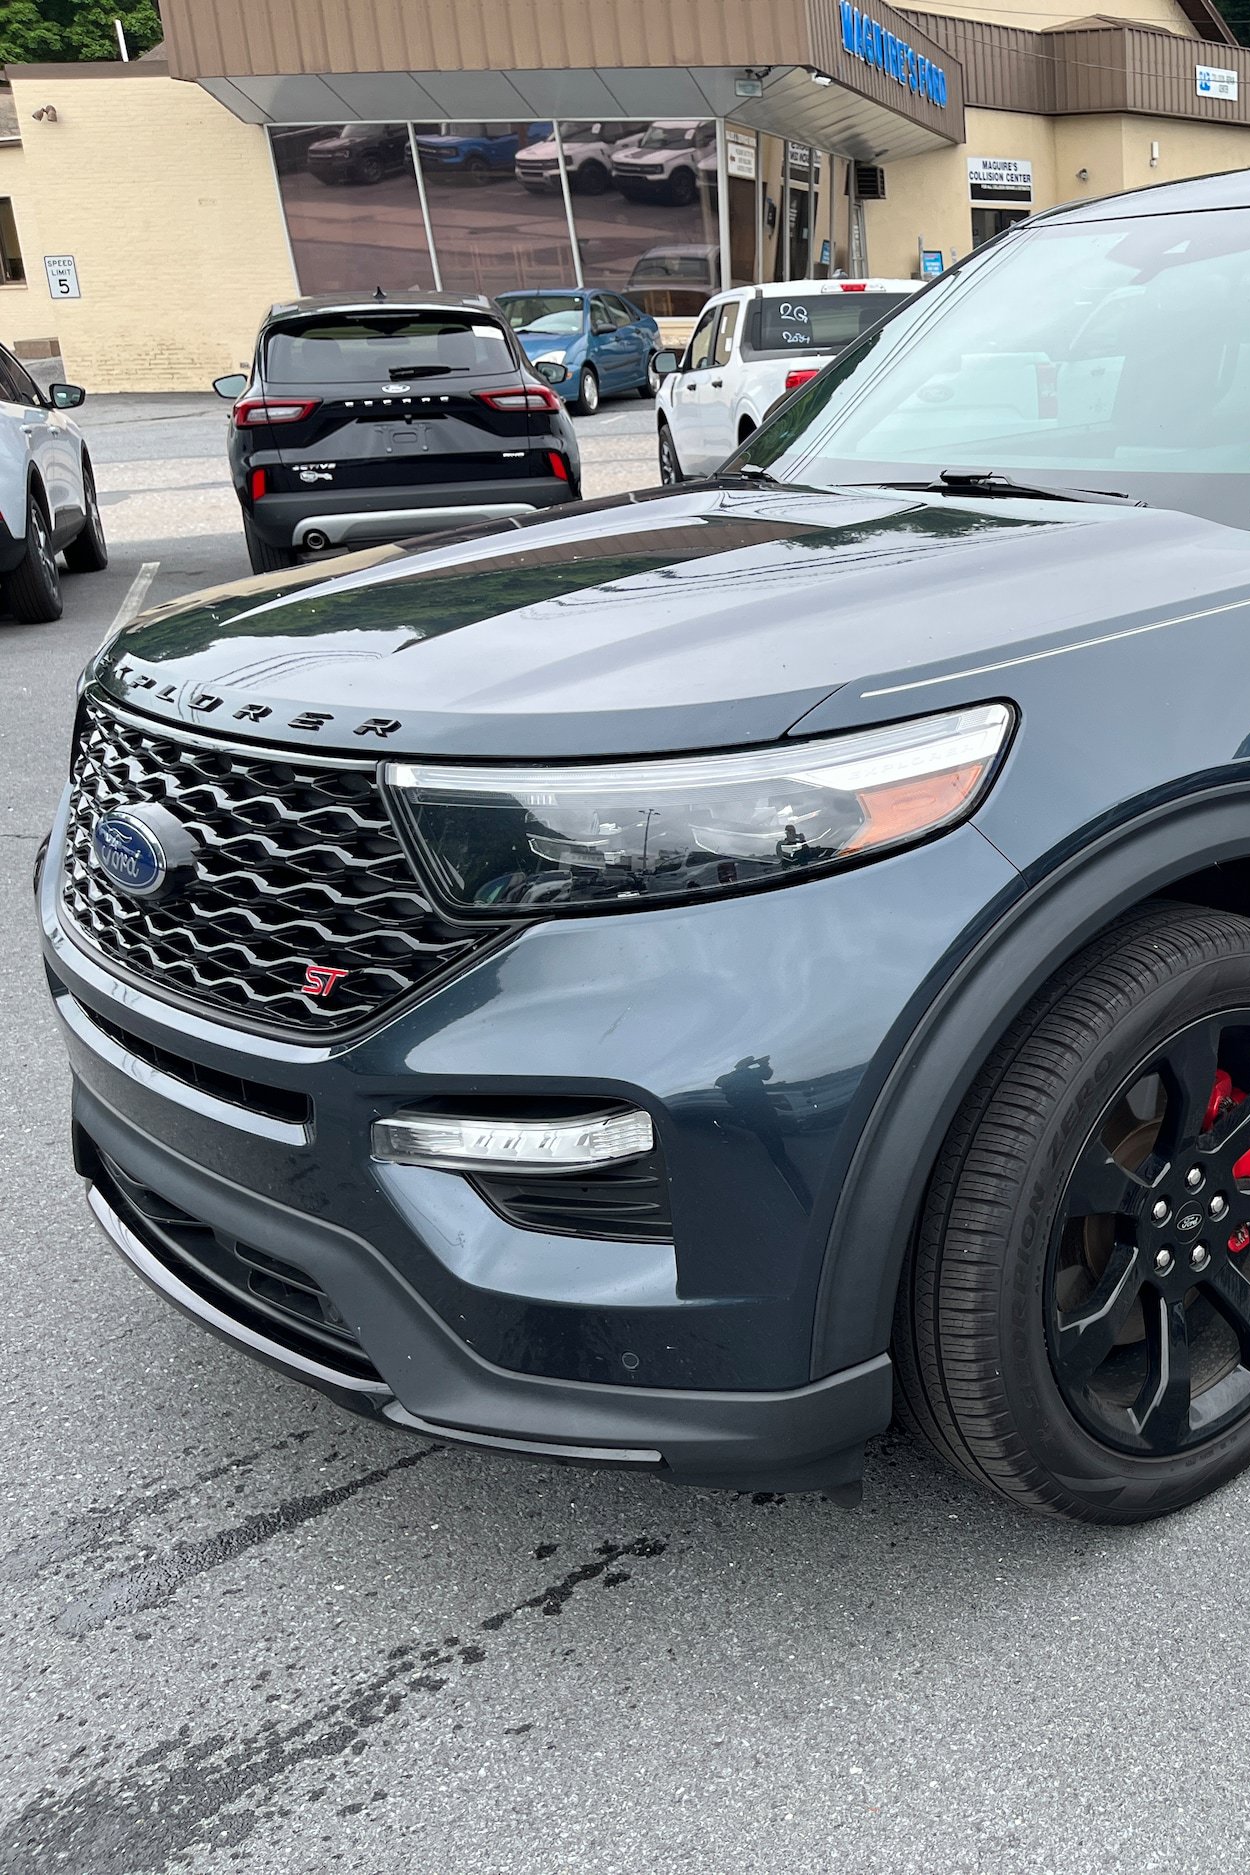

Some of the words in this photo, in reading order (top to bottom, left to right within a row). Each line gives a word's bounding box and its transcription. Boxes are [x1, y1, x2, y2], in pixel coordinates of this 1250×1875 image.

[917, 53, 947, 109] FORD
[969, 171, 1004, 182] COLLISION
[1006, 173, 1032, 183] CENTER
[982, 160, 1018, 171] MAGUIRE'S
[58, 278, 70, 294] 5
[100, 823, 140, 878] Ford
[301, 965, 349, 997] ST
